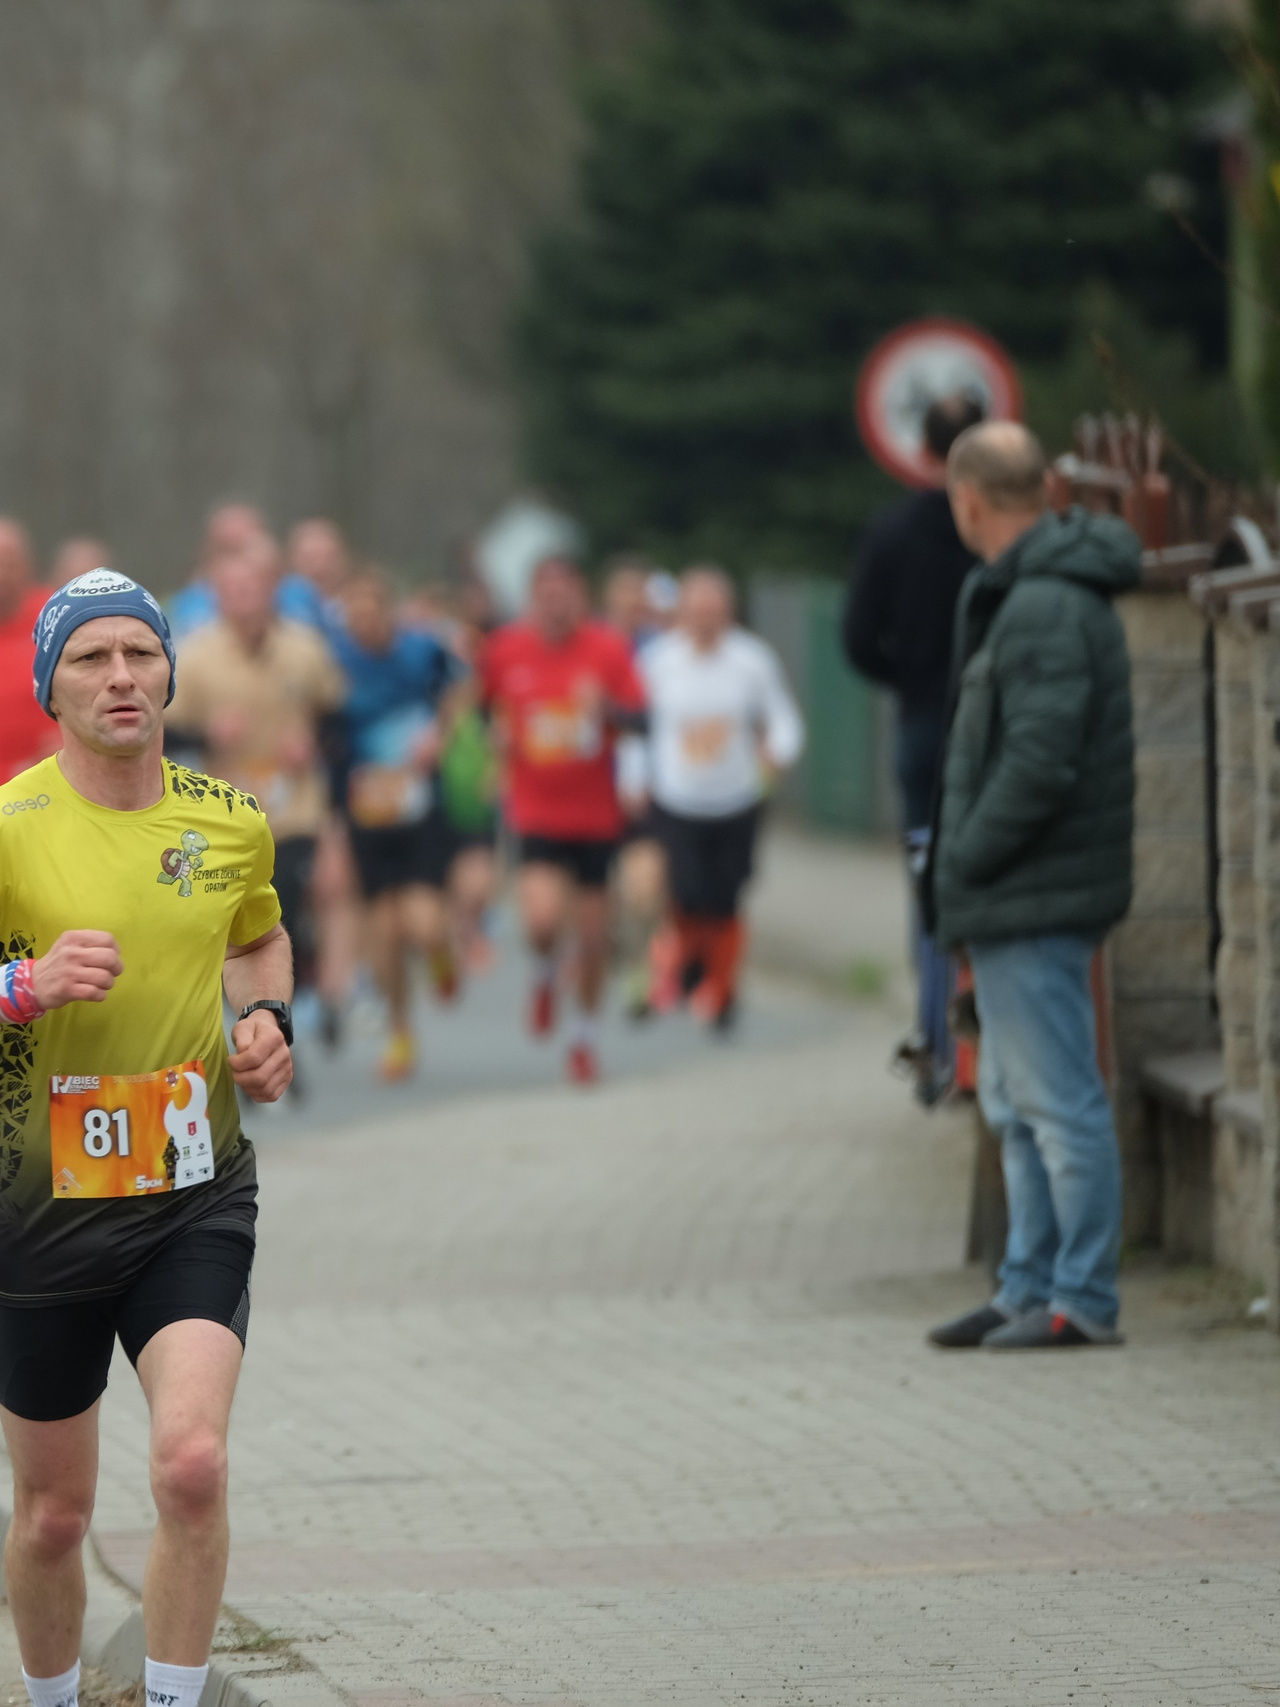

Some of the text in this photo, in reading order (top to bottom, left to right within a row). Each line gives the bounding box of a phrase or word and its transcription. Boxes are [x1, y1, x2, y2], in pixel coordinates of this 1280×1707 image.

[1, 793, 50, 816] deep
[192, 869, 220, 881] SZYBKIE
[72, 1075, 100, 1085] BIEG
[83, 1108, 130, 1158] 81
